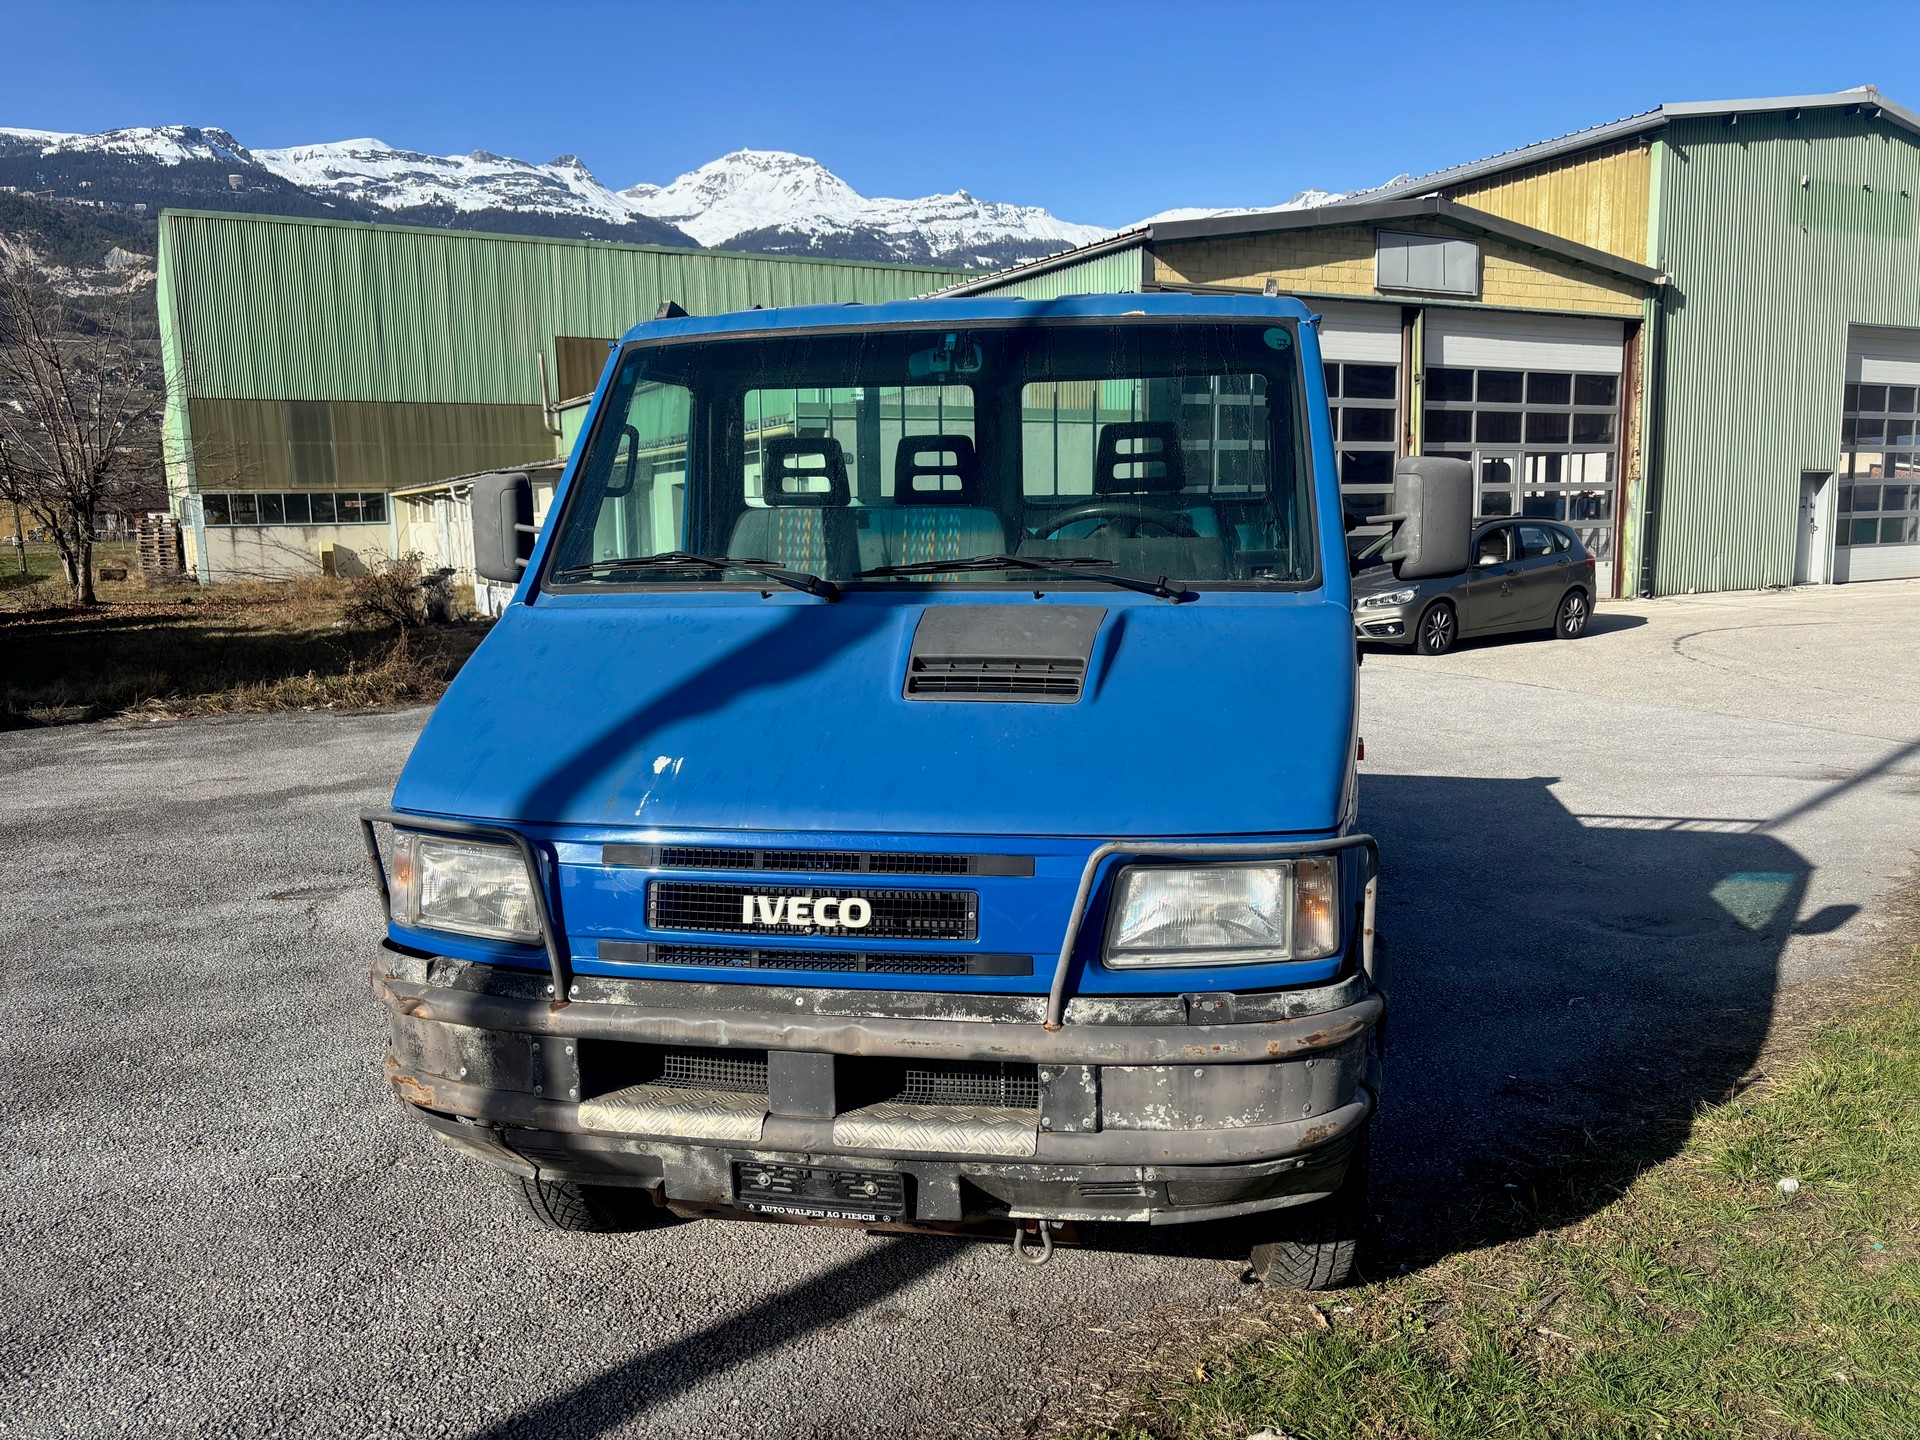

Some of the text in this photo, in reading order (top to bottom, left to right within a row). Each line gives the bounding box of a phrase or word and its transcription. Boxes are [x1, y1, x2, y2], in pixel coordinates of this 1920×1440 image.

[742, 895, 872, 928] IVECO
[760, 1205, 876, 1221] AUTO WALPEN AG FIESCH
